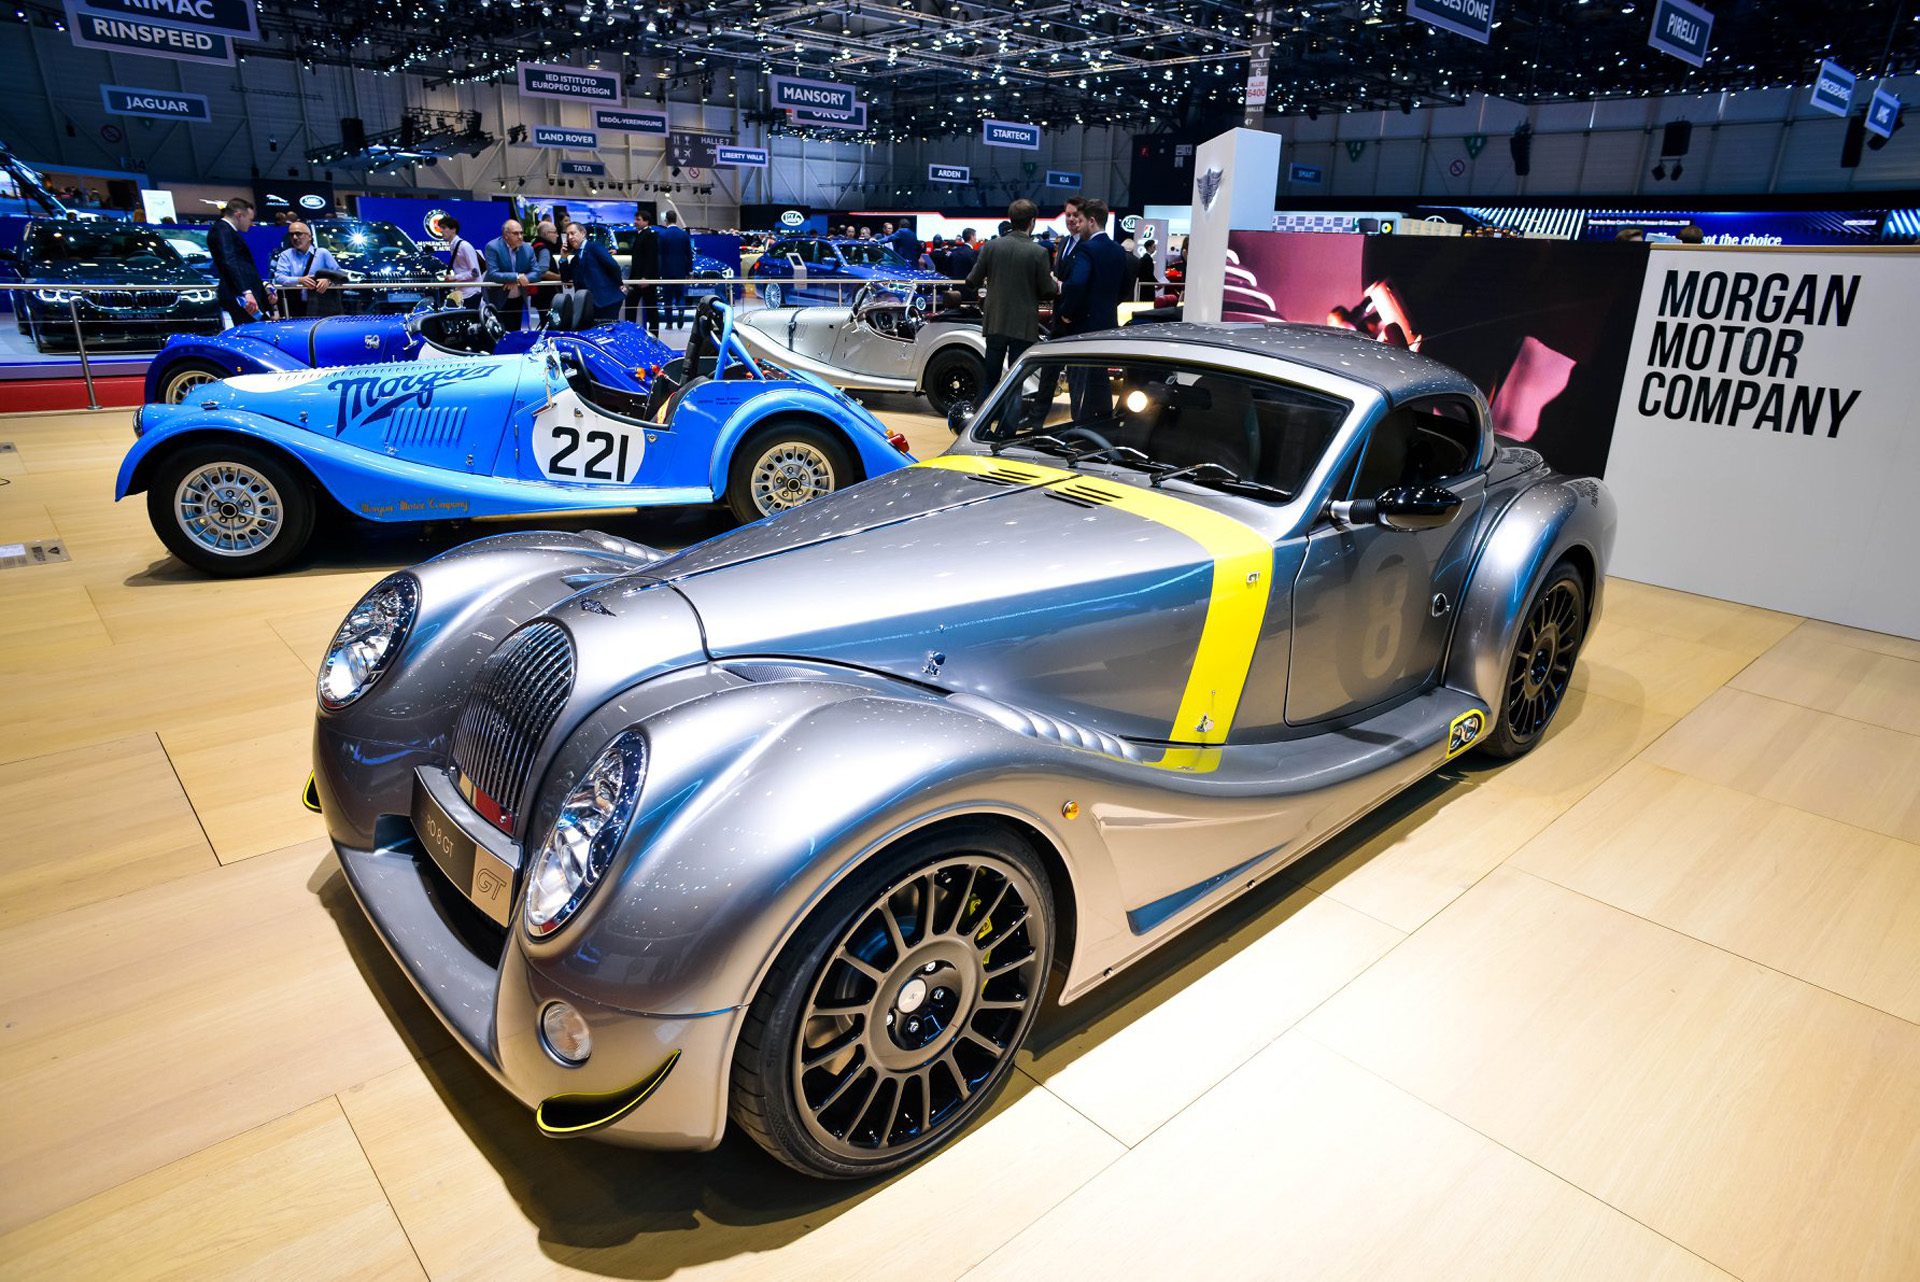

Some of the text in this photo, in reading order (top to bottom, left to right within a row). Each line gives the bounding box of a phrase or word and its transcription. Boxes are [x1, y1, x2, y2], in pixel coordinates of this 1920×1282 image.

[93, 18, 213, 50] RINSPEED
[1667, 13, 1700, 46] PIRELLI
[532, 80, 570, 92] EUROPEO
[581, 87, 611, 96] DESIGN
[545, 73, 597, 86] IED ISTITUTO
[783, 86, 846, 106] MANSORY
[1247, 88, 1266, 98] 6400
[125, 96, 190, 113] JAGUAR
[538, 132, 594, 144] LAND ROVER
[701, 136, 724, 145] HALLE
[992, 128, 1031, 141] STARTECH
[573, 164, 593, 173] TATA
[937, 169, 962, 179] ARDEN
[1719, 233, 1739, 246] the
[1741, 233, 1783, 246] choice
[1657, 269, 1862, 327] MORGAN
[1647, 321, 1804, 379] MOTOR
[327, 365, 505, 437] Morgan
[1638, 371, 1862, 439] COMPANY
[548, 426, 630, 482] 221
[477, 868, 507, 901] GT
